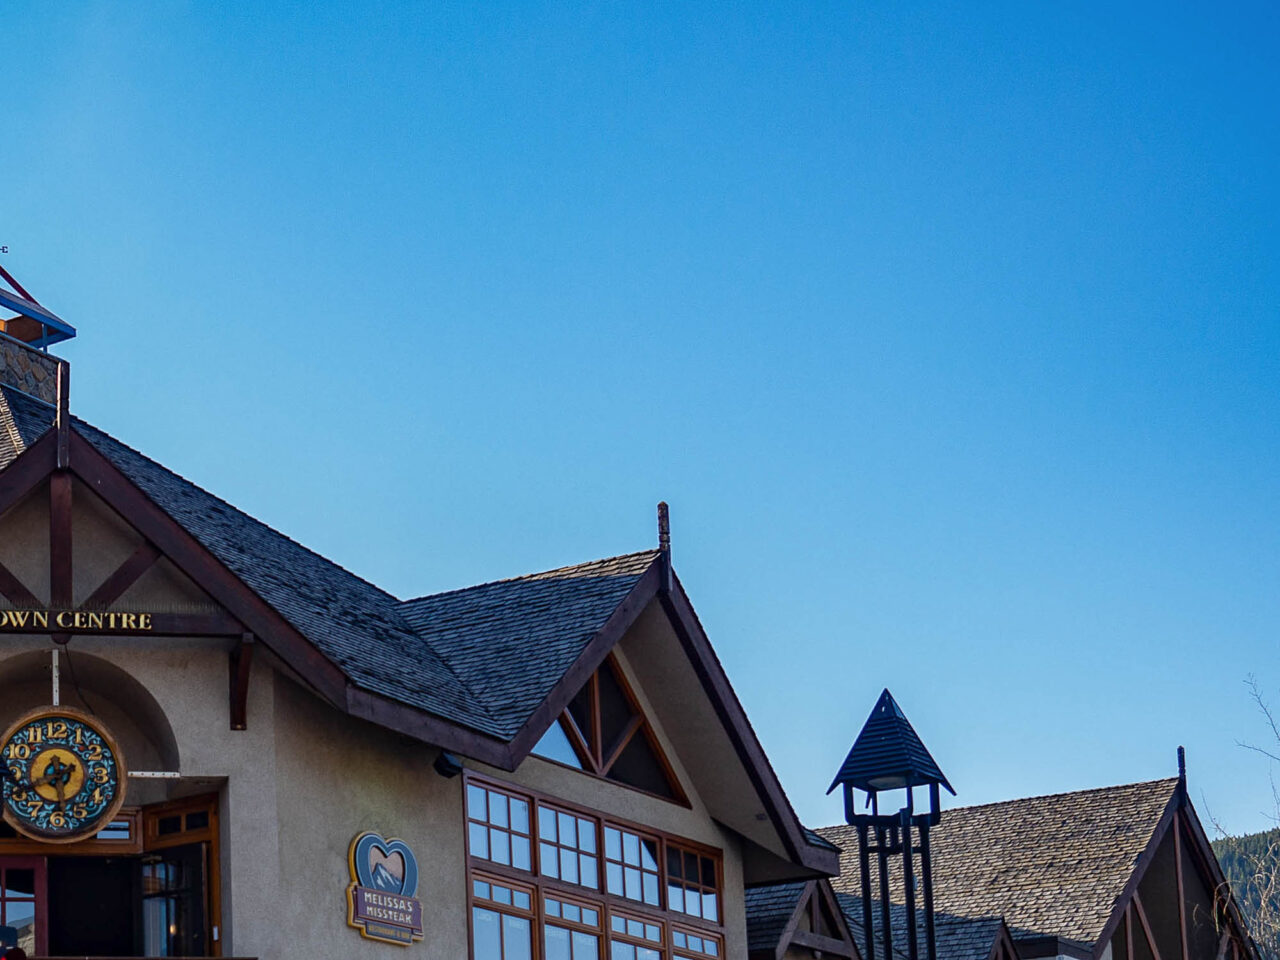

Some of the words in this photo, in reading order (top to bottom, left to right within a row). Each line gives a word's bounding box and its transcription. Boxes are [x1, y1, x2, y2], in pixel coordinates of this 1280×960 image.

[56, 611, 152, 630] CENTRE
[28, 727, 43, 743] 11
[46, 722, 68, 739] 12
[75, 728, 83, 744] 1
[8, 743, 31, 760] 10
[88, 744, 103, 761] 2
[93, 767, 109, 784] 3
[92, 787, 104, 804] 4
[27, 801, 44, 818] 7
[73, 802, 88, 819] 5
[49, 811, 66, 827] 6
[366, 906, 412, 924] MISSTEAK
